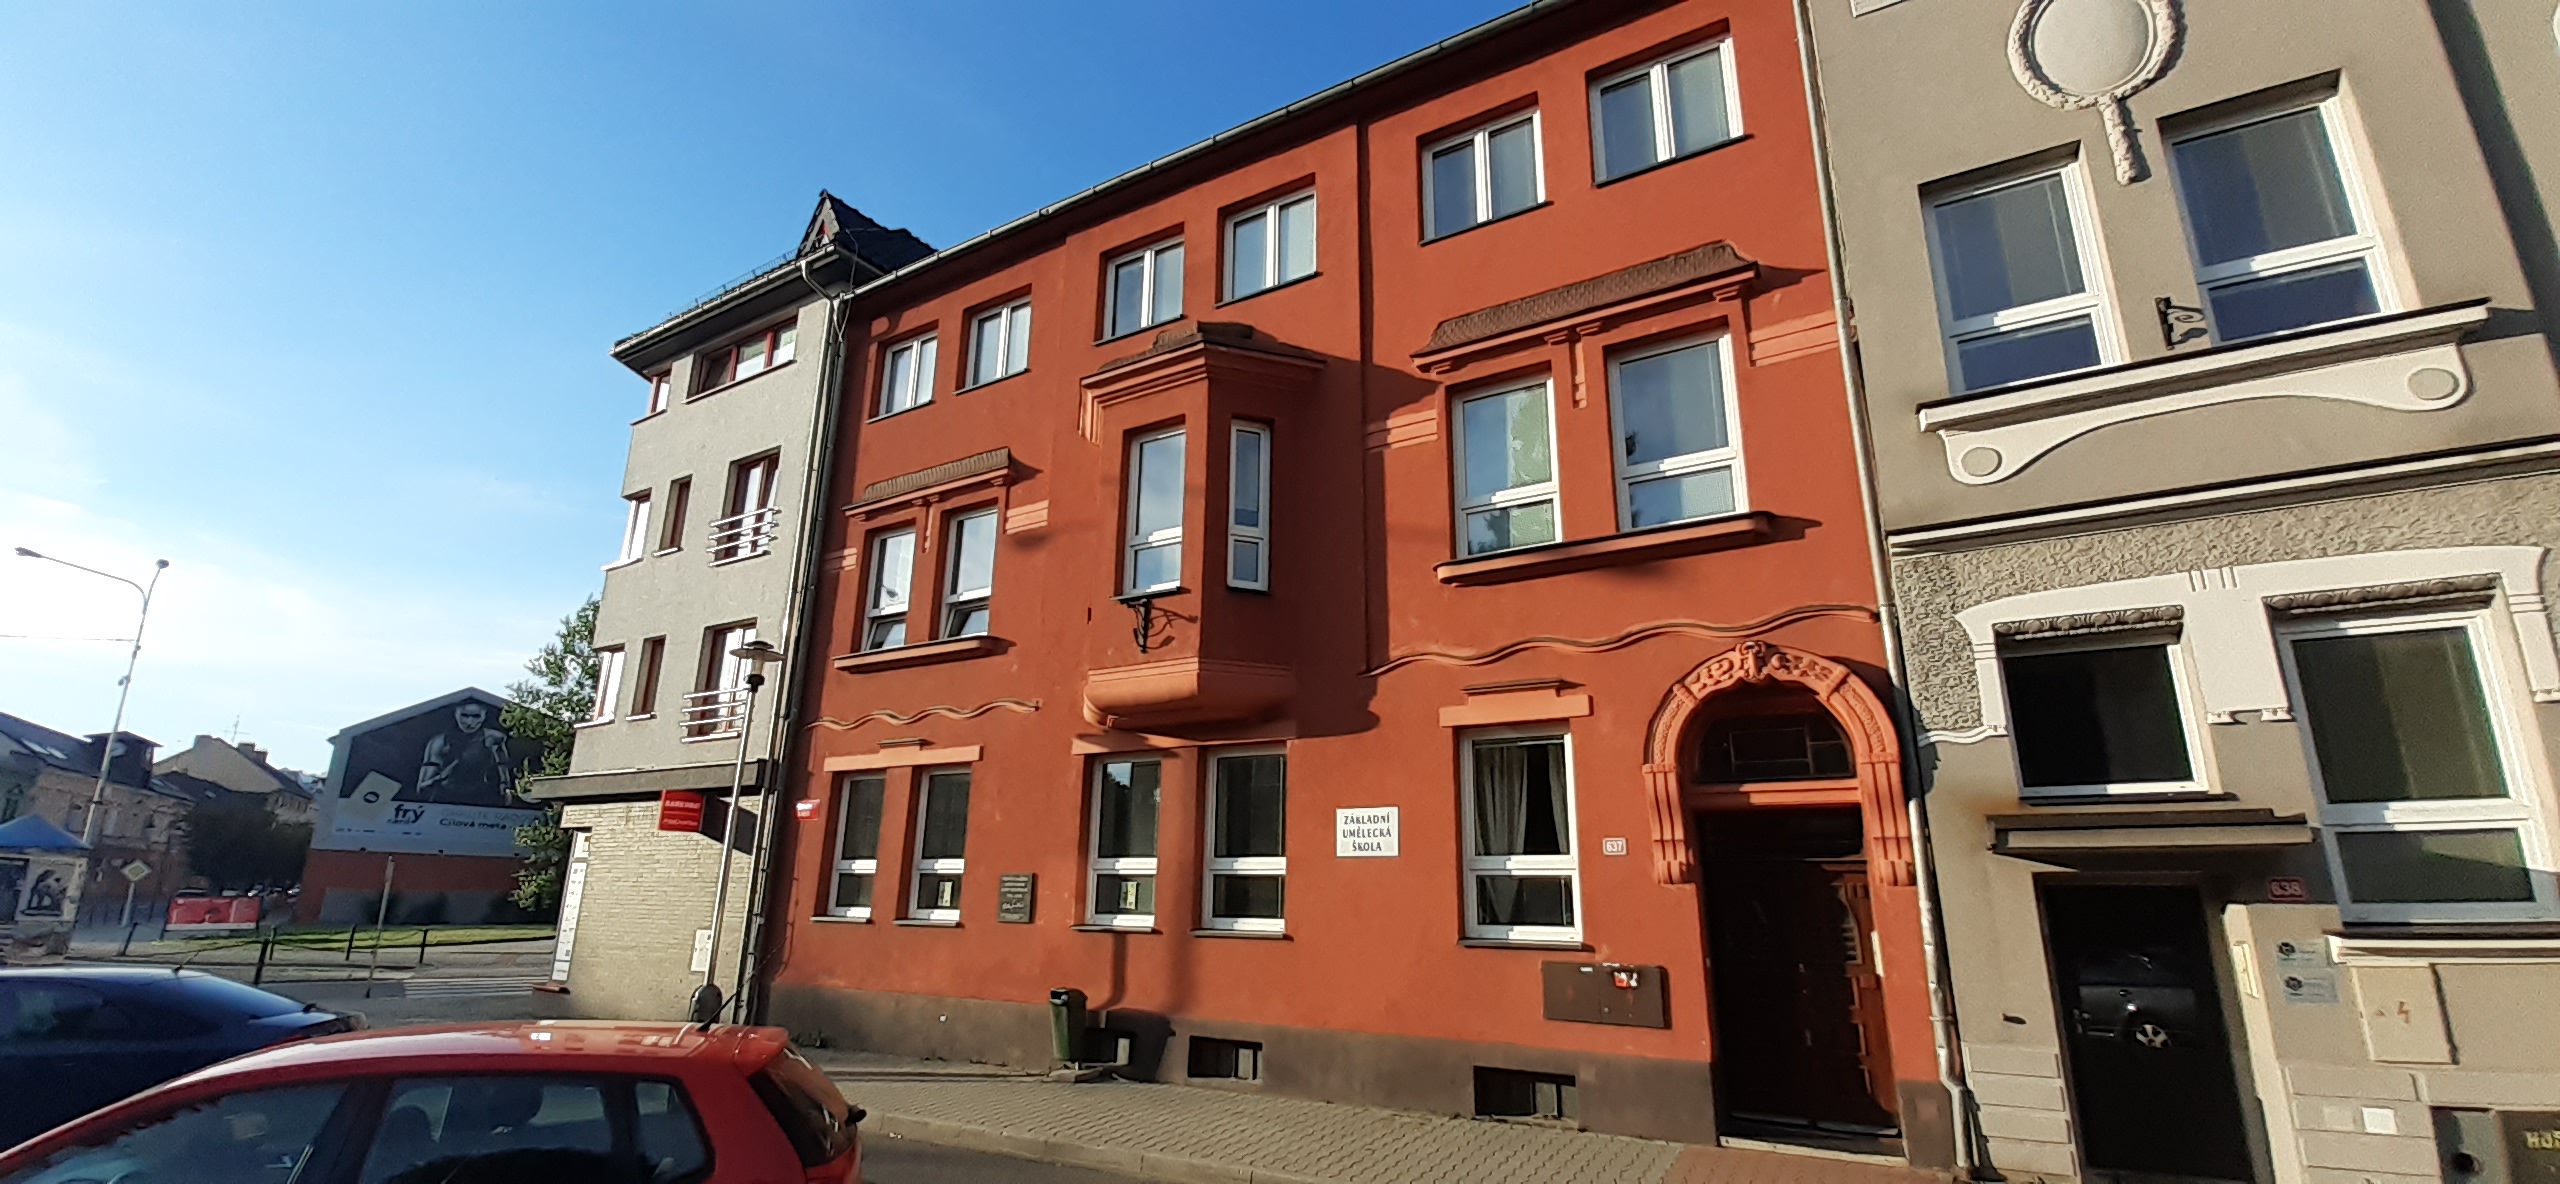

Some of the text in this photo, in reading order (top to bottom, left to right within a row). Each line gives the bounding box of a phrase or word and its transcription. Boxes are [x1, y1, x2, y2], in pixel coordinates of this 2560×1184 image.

[394, 803, 426, 824] frý
[1343, 811, 1391, 825] ZÁKLADNÍ
[1342, 825, 1392, 839] UMĚLECKÁ
[1352, 839, 1383, 852] ŠKOLA
[1606, 840, 1623, 852] 637
[2271, 881, 2302, 896] 638
